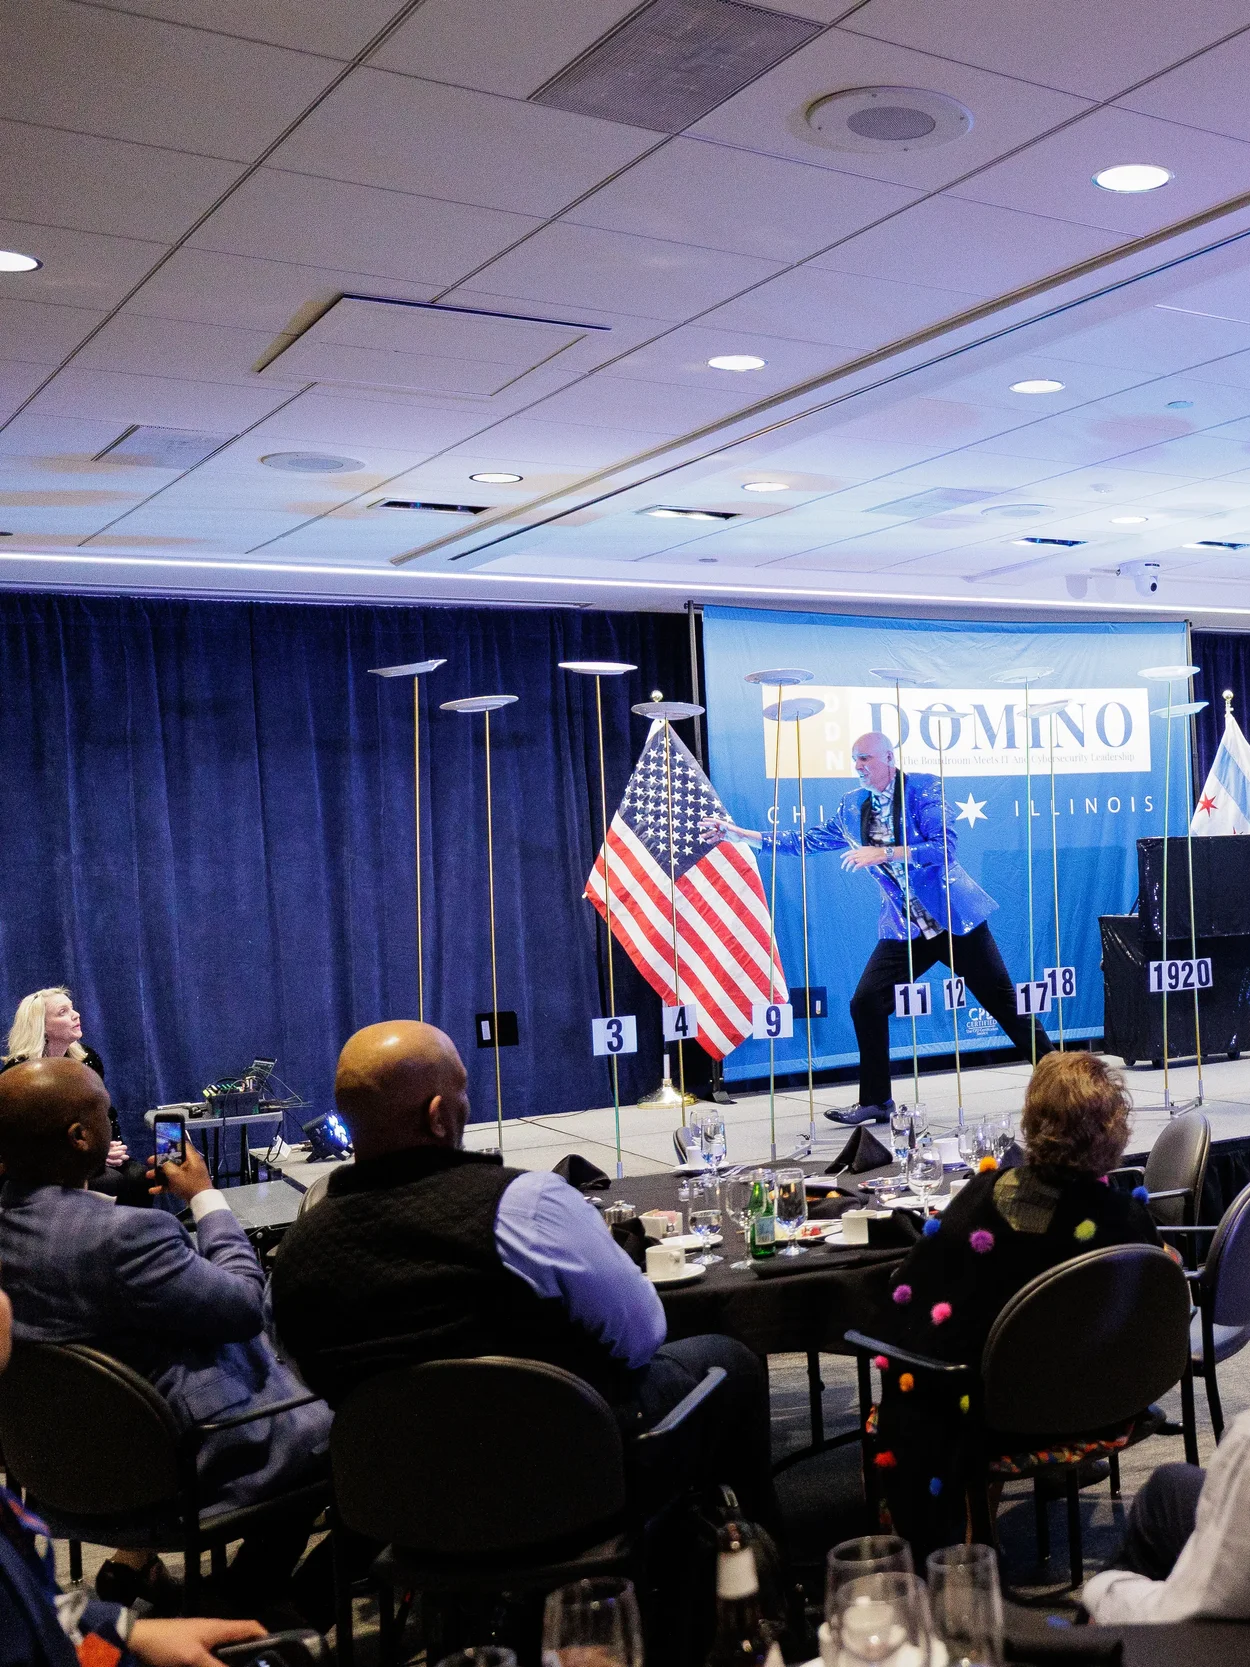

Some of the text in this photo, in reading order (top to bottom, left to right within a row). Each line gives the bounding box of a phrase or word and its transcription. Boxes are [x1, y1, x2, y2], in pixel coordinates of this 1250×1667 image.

[867, 702, 1133, 751] DOMINO
[973, 755, 999, 765] Meets
[1031, 753, 1088, 765] Cybersecurity
[1091, 752, 1135, 763] Leadership
[1015, 796, 1153, 817] ILLINOIS
[946, 979, 965, 1008] 12
[1020, 982, 1048, 1012] 17
[1048, 968, 1074, 996] 18
[900, 985, 927, 1015] 11
[607, 1018, 624, 1052] 3
[675, 1006, 688, 1037] 4
[766, 1005, 781, 1037] 9
